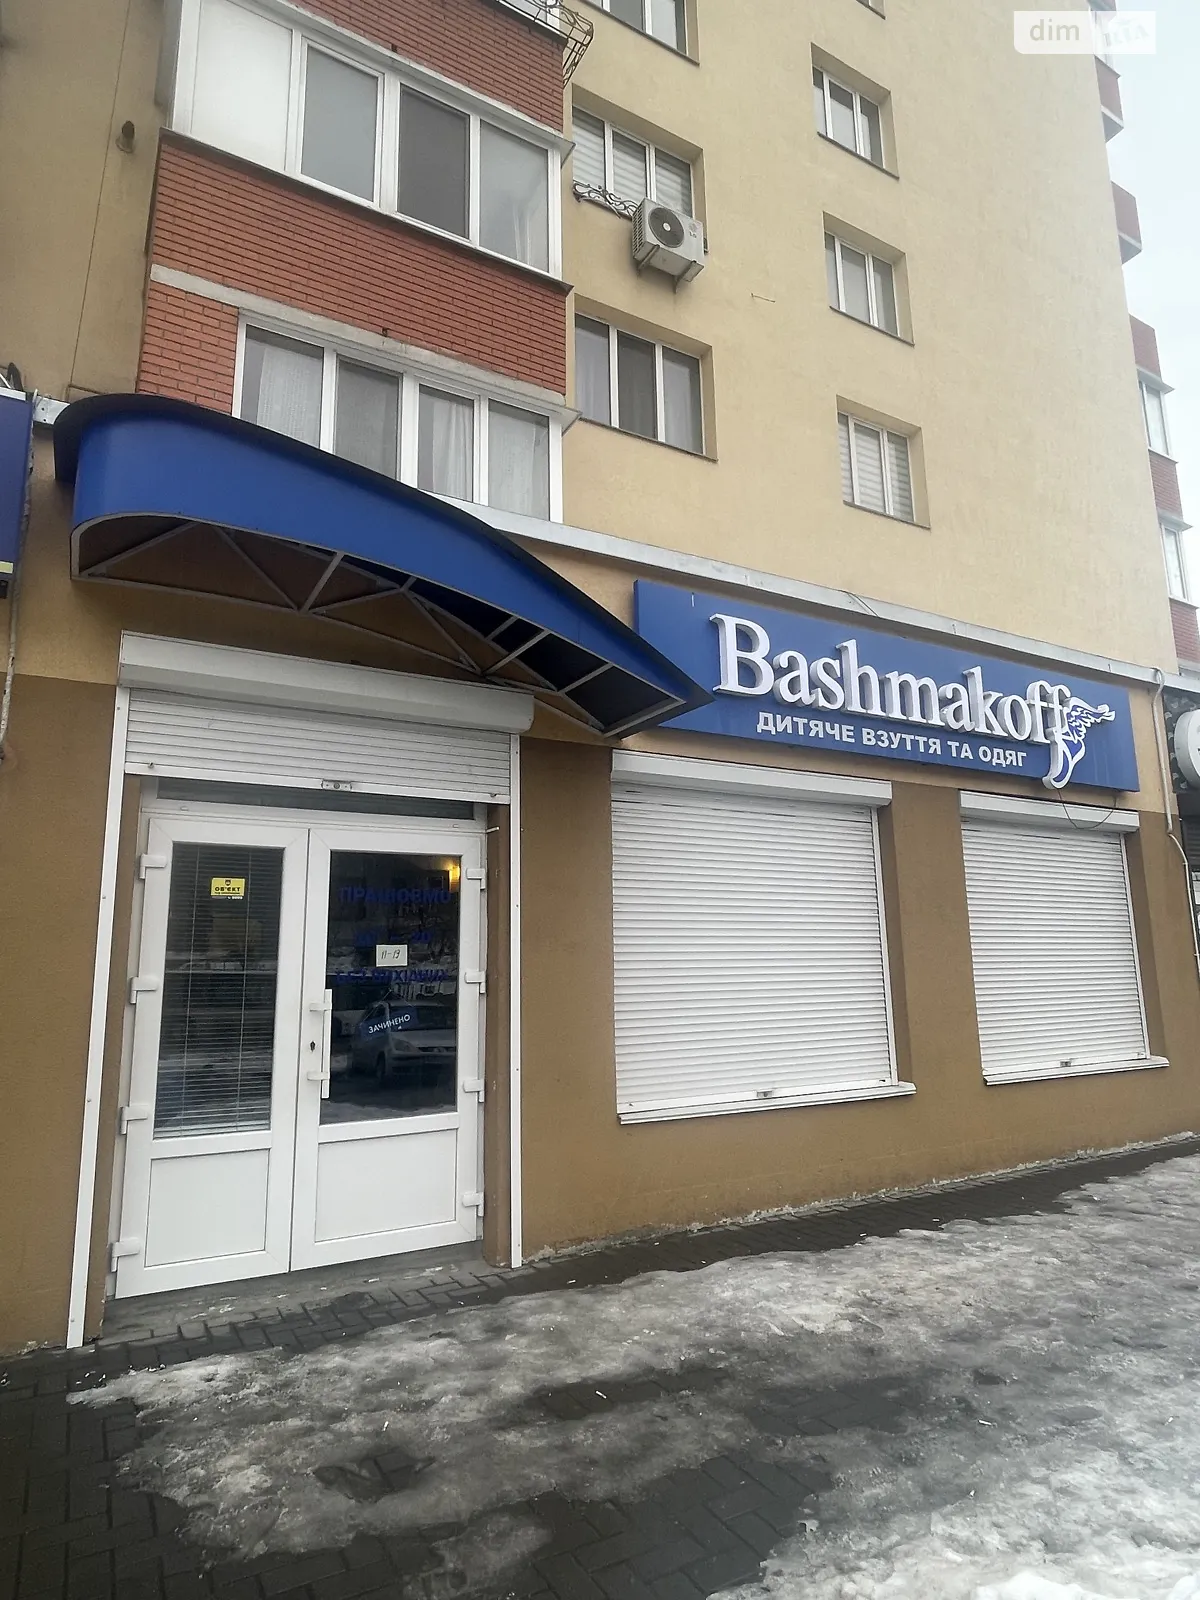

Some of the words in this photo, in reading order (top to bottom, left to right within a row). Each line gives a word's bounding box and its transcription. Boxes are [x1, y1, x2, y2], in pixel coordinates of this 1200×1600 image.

[709, 612, 1073, 788] Bashmakoff
[756, 711, 856, 743] ДИТЯЧЕ
[861, 727, 942, 755] ВЗУТТЯ
[946, 740, 974, 760] ТА
[978, 745, 1027, 768] ОДЯГ
[368, 1014, 411, 1034] ЗАЧИНЕНО
